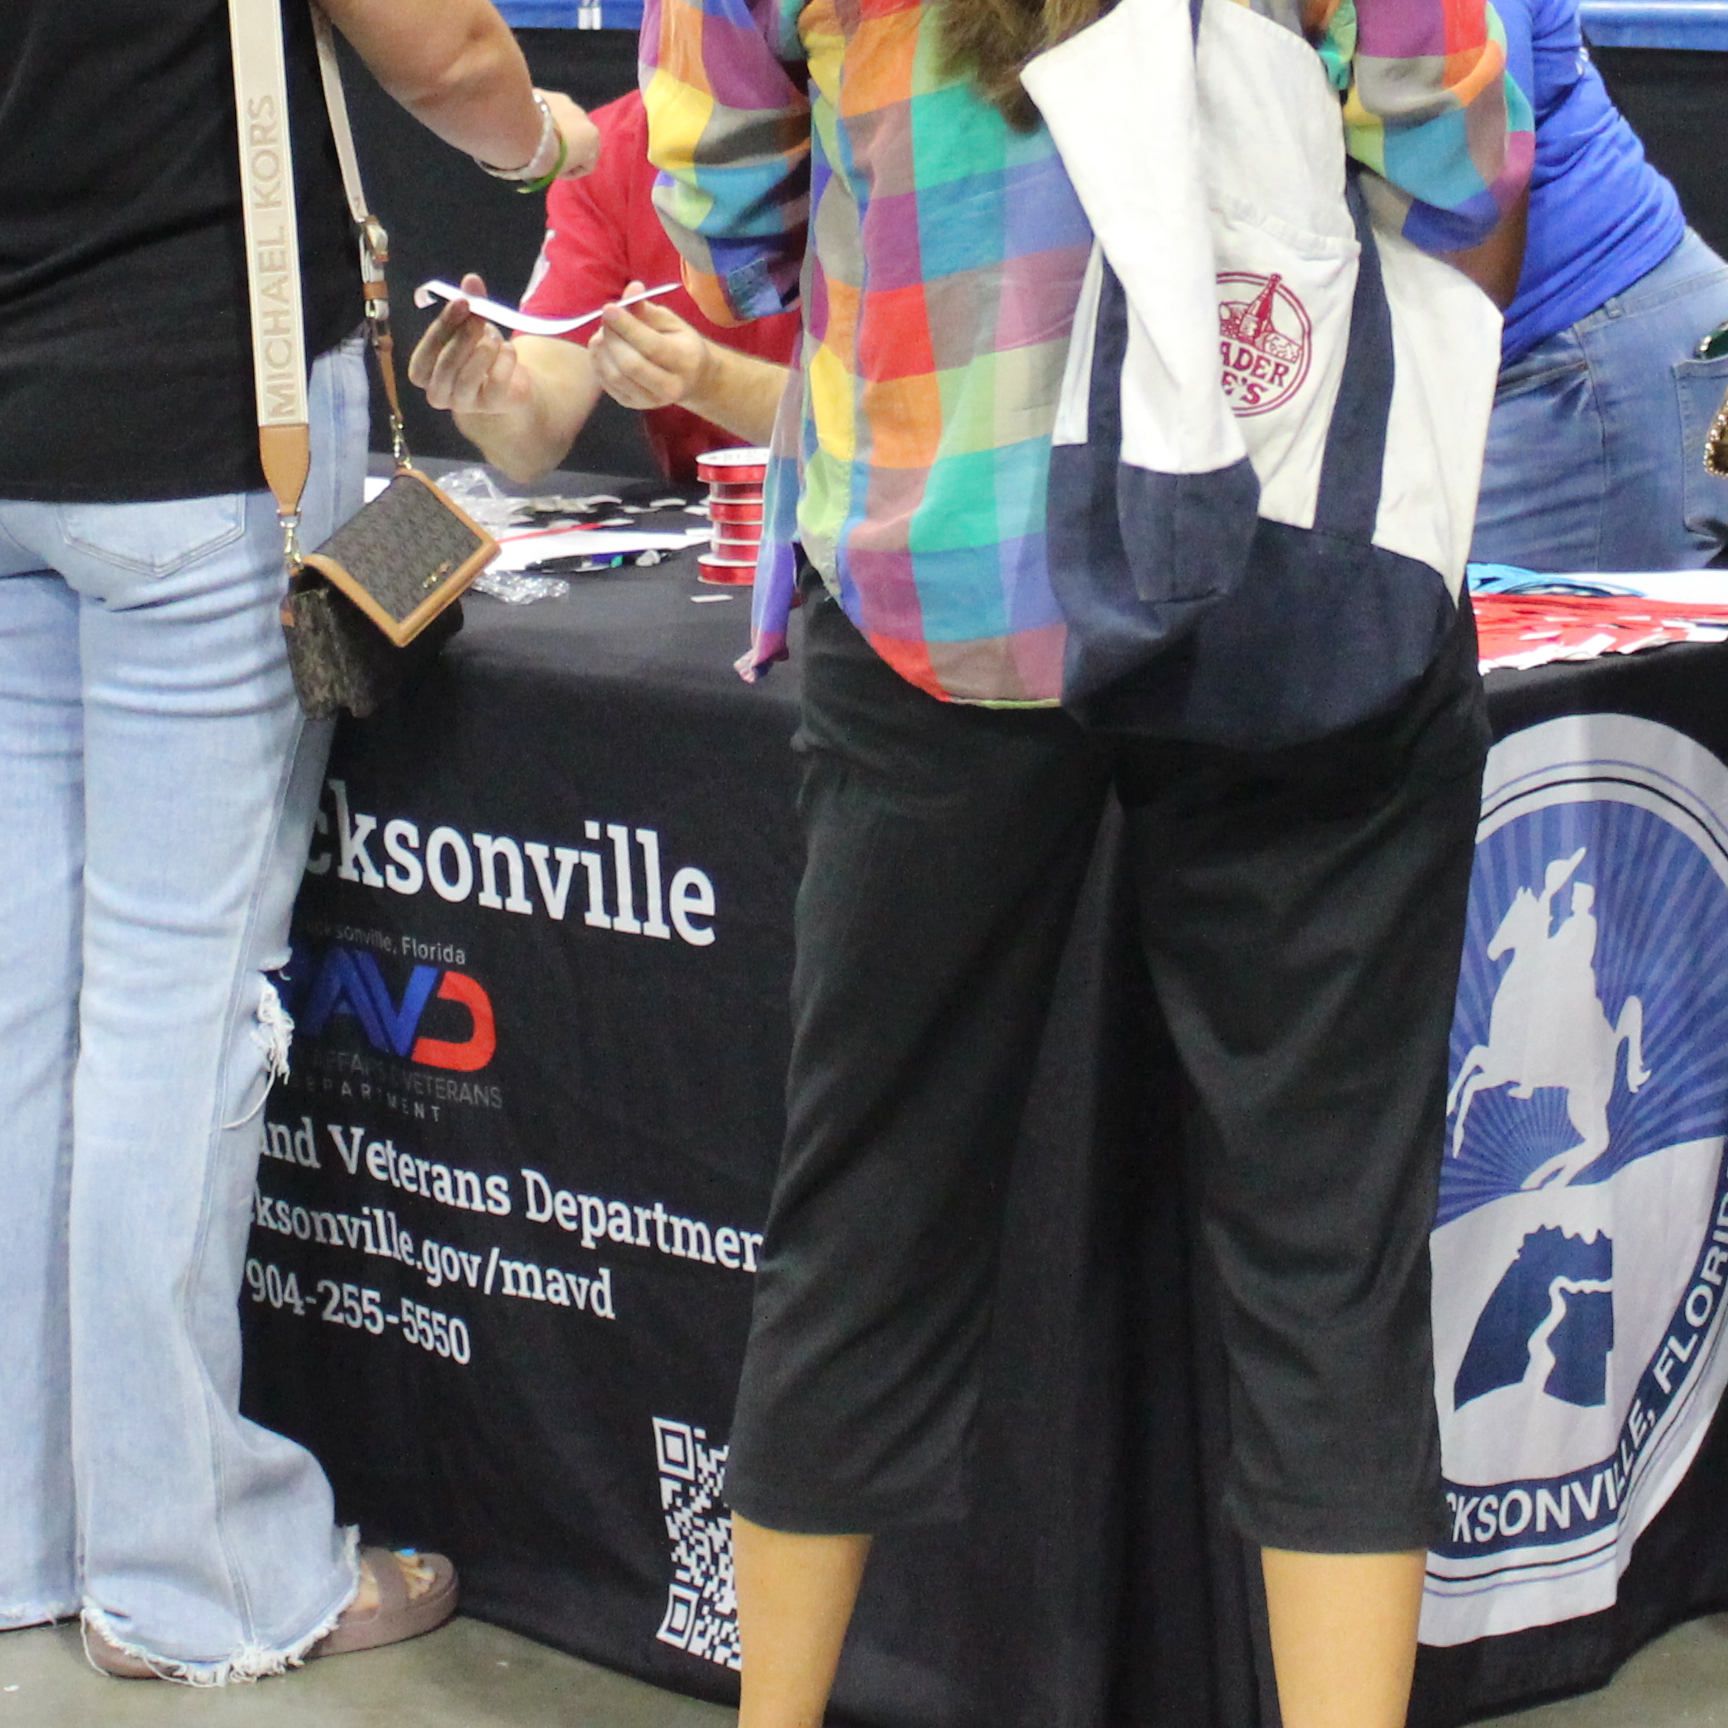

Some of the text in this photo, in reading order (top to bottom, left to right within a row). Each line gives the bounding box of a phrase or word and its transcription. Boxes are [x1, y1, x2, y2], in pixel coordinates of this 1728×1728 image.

[248, 94, 295, 418] MICHAEL KORS
[402, 936, 466, 965] Florida
[402, 1072, 504, 1109] VETERANS
[327, 1124, 512, 1217] Veterans
[245, 1257, 471, 1365] 904-255-5550
